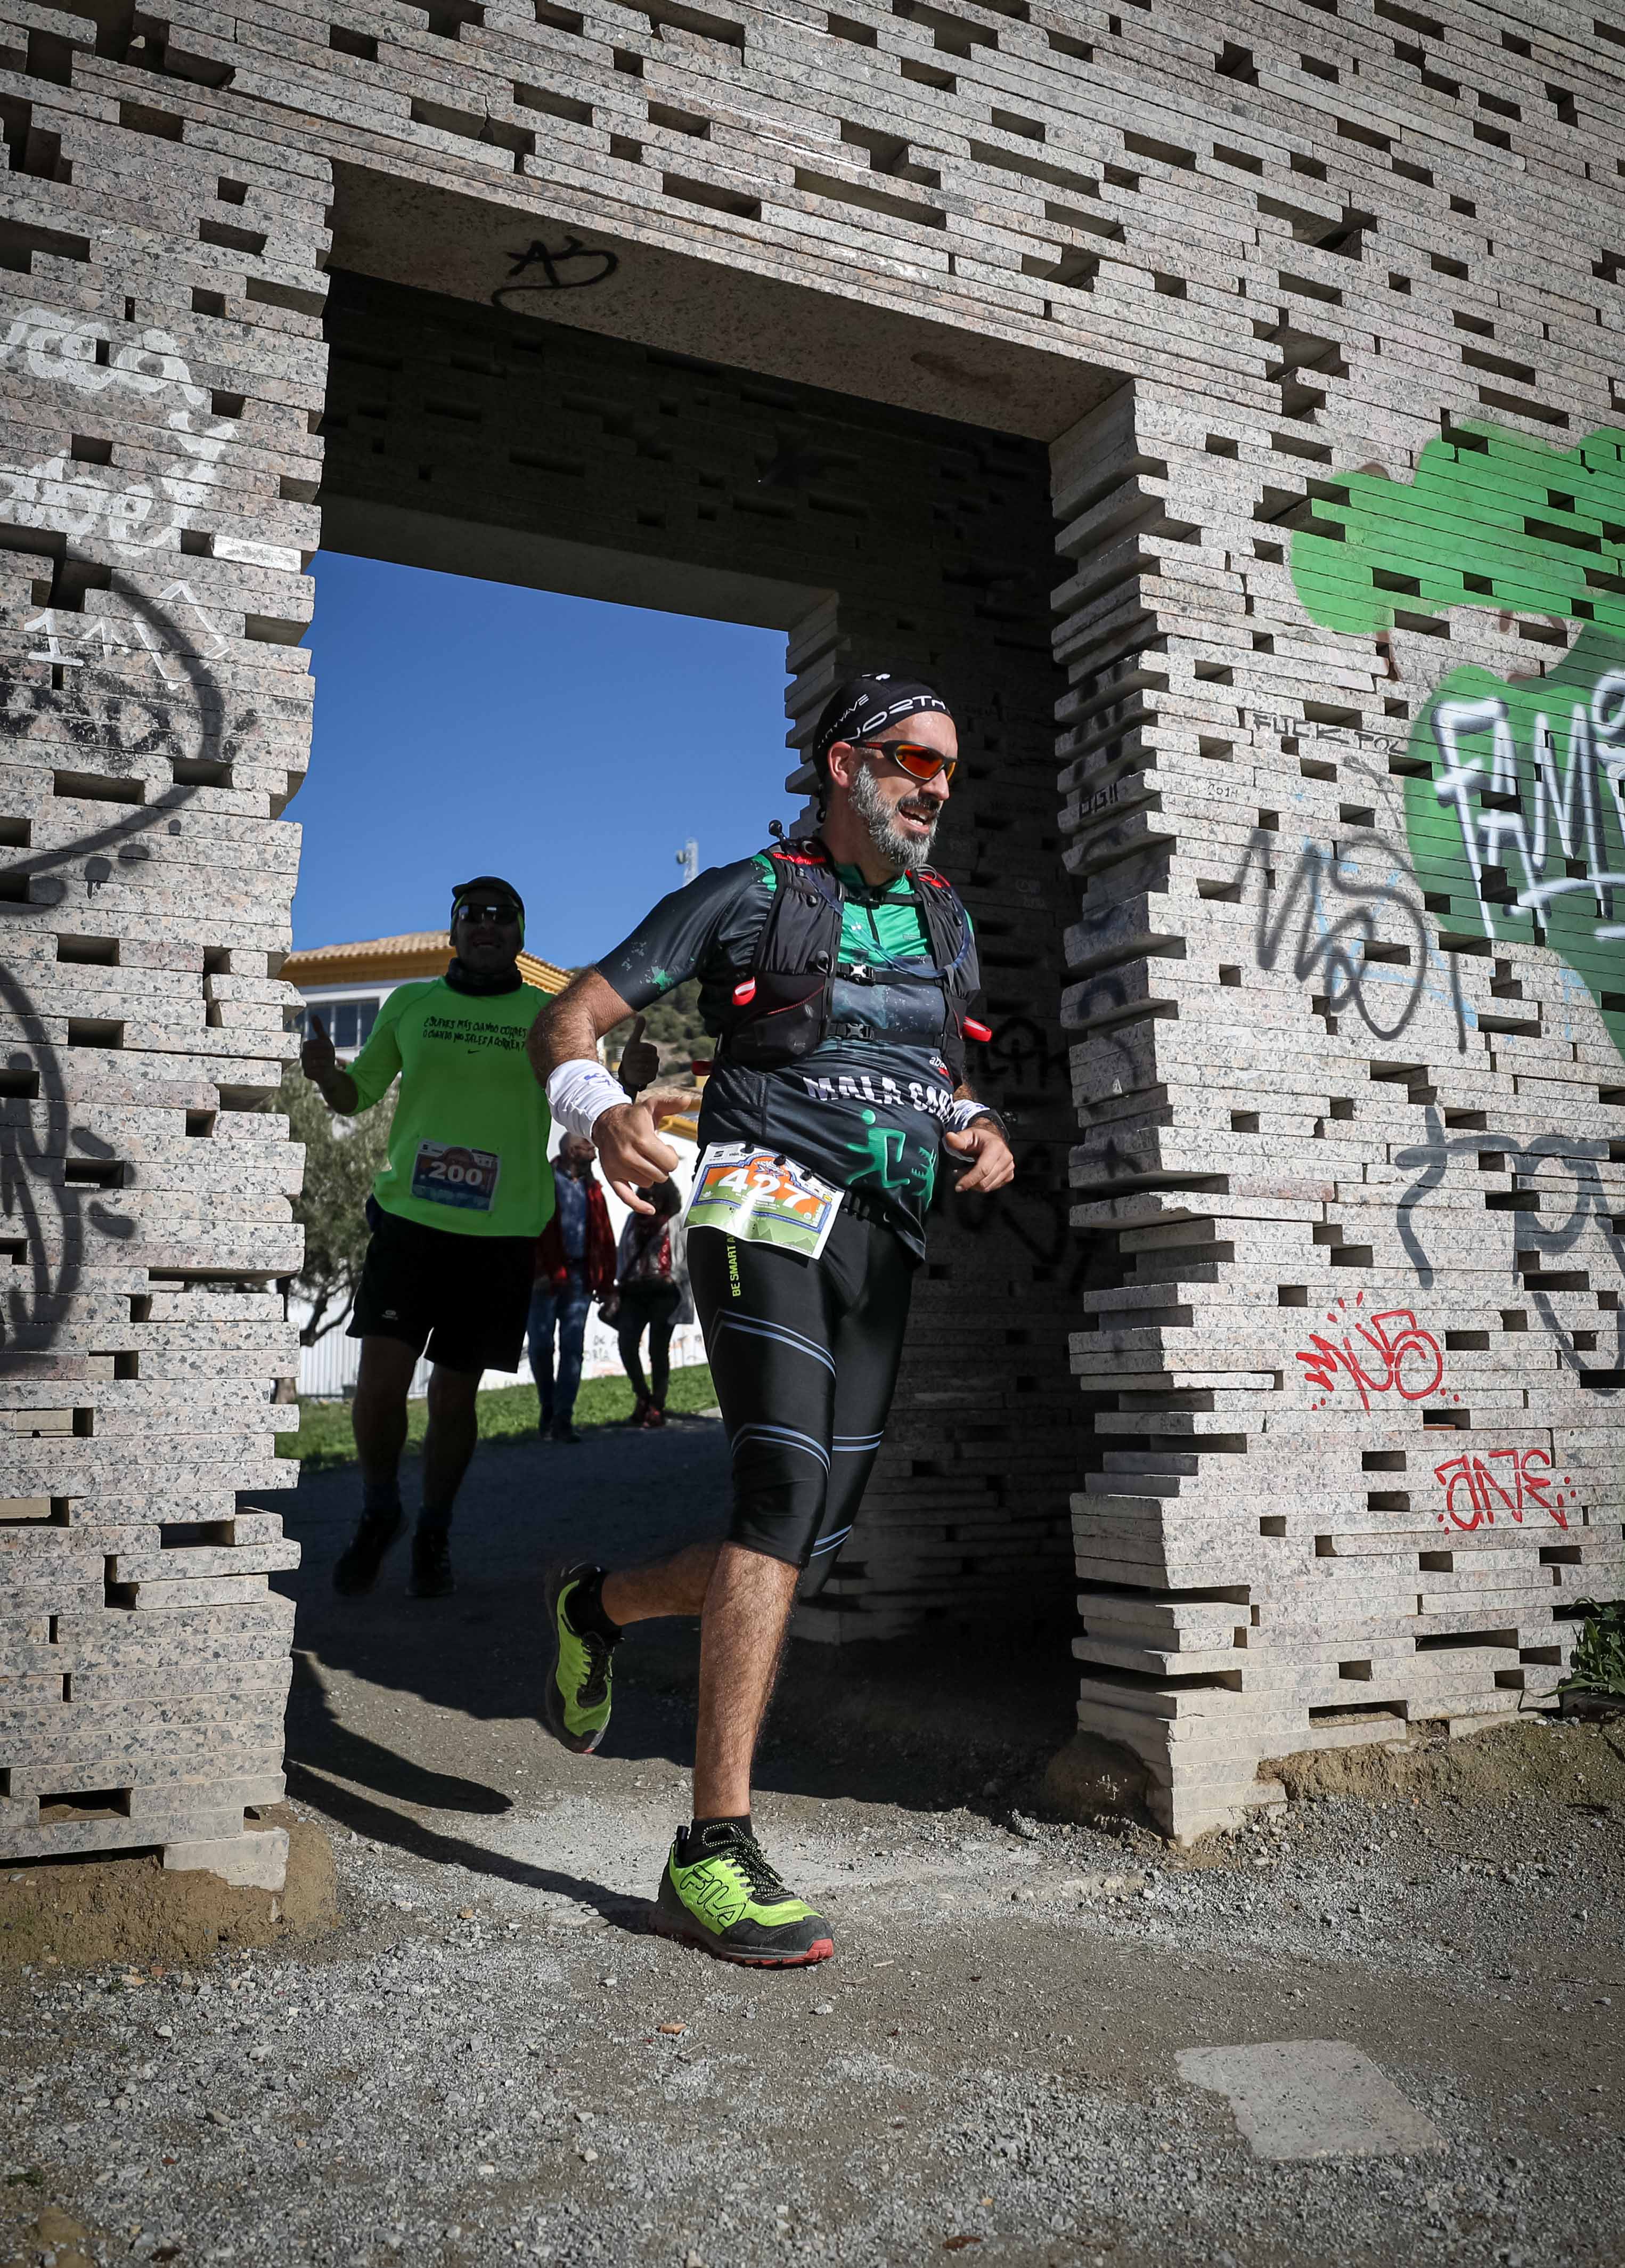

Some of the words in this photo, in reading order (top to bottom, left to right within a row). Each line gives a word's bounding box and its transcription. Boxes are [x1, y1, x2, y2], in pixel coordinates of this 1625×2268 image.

[1253, 713, 1350, 745] FUCK
[428, 1029, 453, 1040] CUANDO
[464, 1033, 487, 1045] SALES
[473, 1022, 499, 1034] CUANDO
[500, 1026, 527, 1038] CORRES
[803, 1075, 905, 1105] MALA
[428, 1161, 483, 1185] 200
[718, 1167, 812, 1209] 427
[726, 1246, 739, 1281] SMART
[732, 1282, 741, 1297] BE
[680, 1864, 746, 1929] FILA
